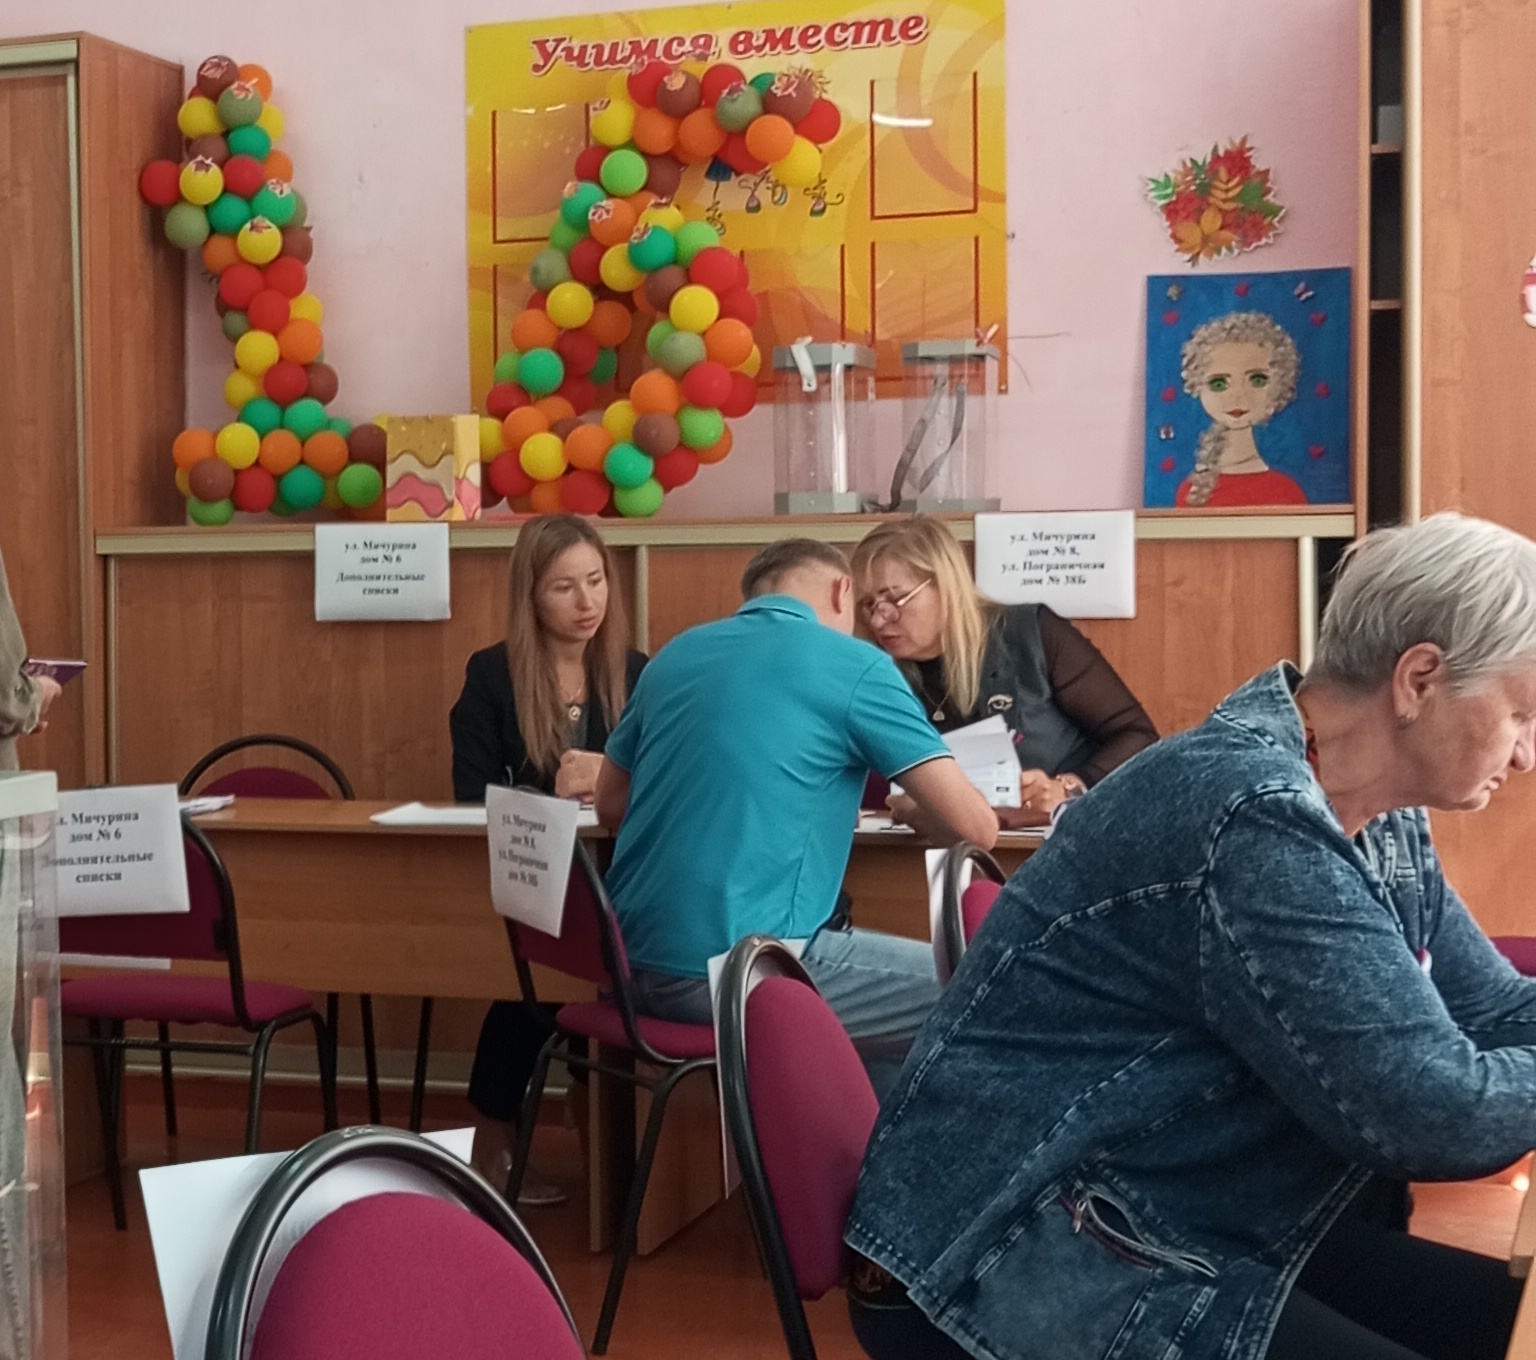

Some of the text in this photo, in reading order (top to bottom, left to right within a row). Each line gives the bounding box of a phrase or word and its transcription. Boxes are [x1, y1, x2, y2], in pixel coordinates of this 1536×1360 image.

[530, 14, 931, 76] Учимся вместе
[1032, 532, 1095, 543] Мичурина
[363, 541, 416, 553] Мичурина
[1022, 561, 1104, 572] Пограничная
[71, 812, 139, 826] Мичурина
[69, 828, 122, 844] дом № 6
[75, 871, 123, 883] списки
